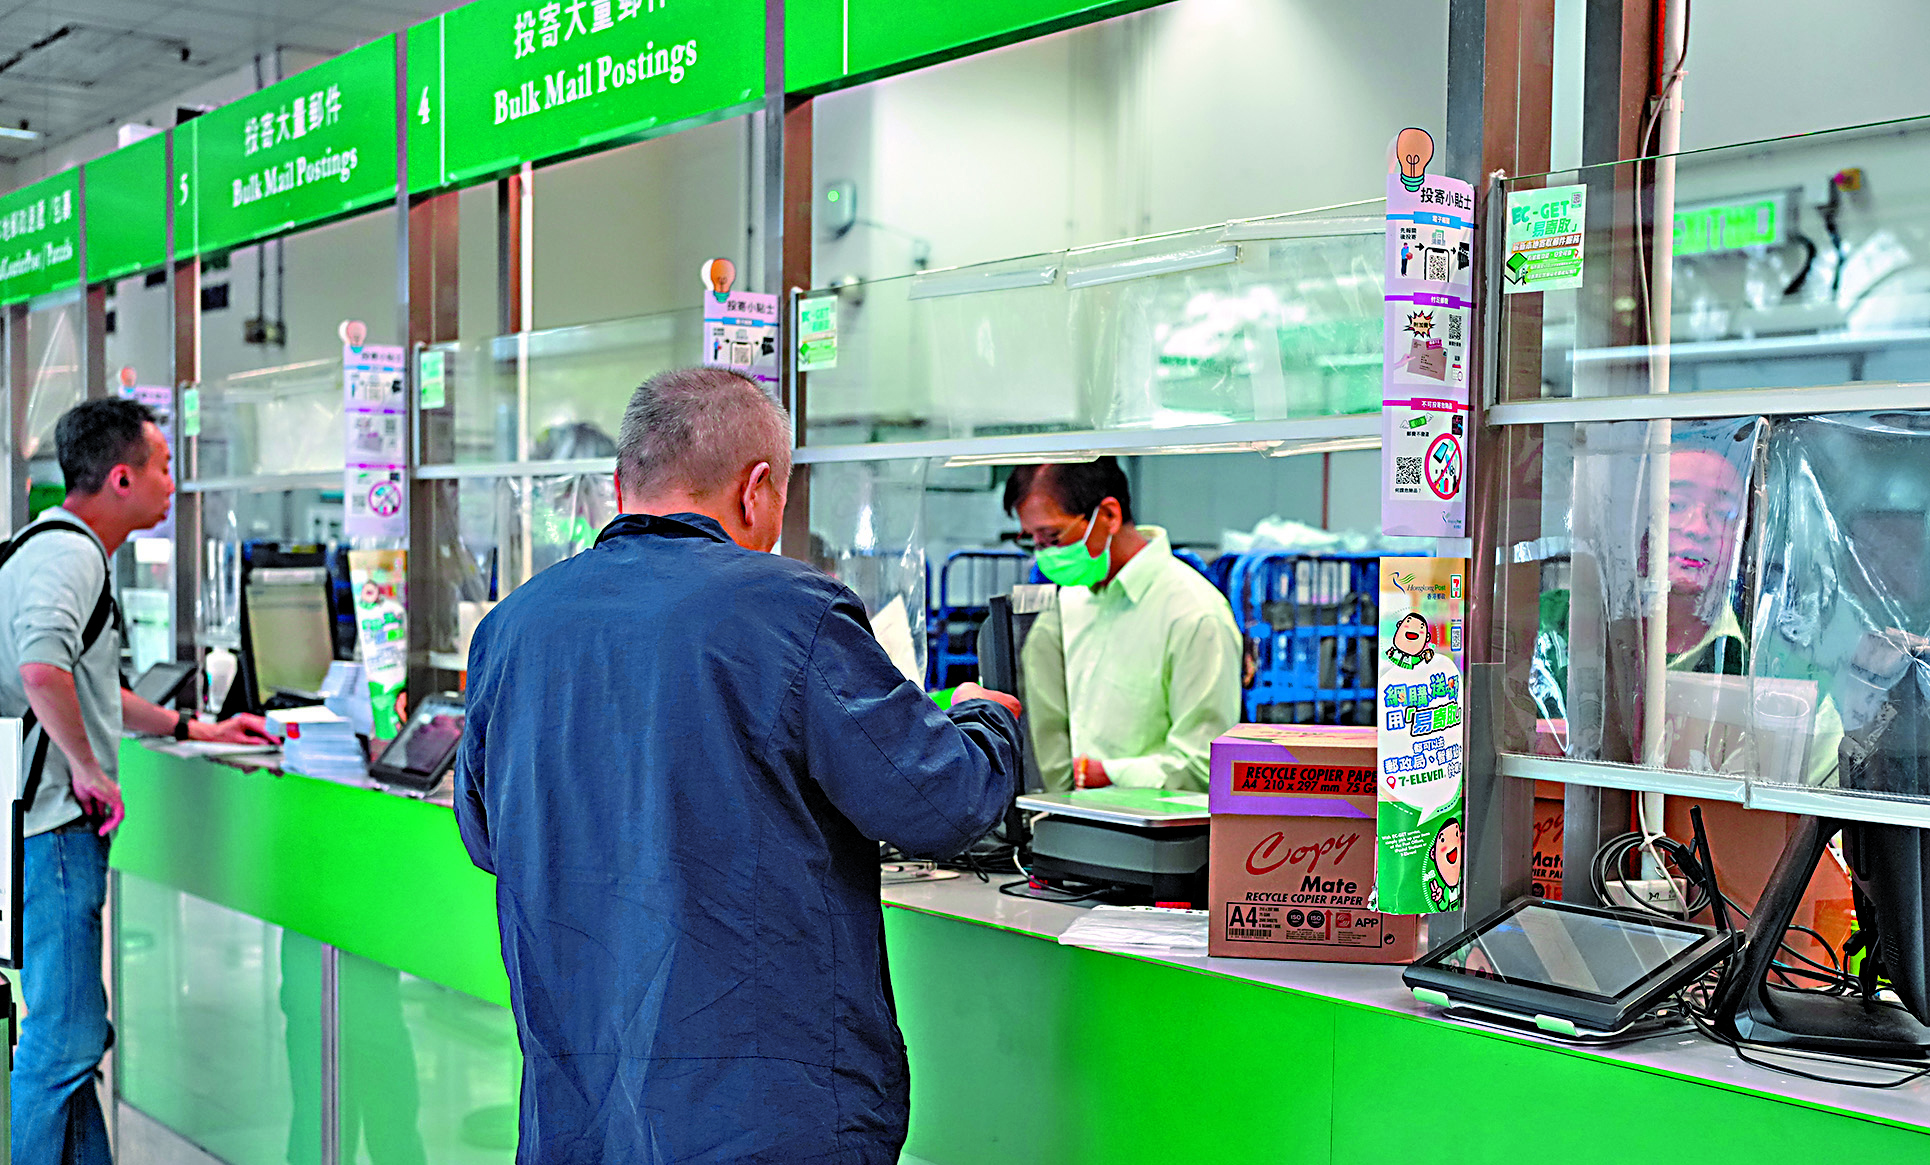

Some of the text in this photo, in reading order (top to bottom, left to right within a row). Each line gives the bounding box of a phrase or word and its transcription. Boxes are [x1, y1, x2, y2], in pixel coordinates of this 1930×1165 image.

[513, 0, 666, 59] 投寄大量
[494, 39, 698, 125] Bulk Mail Postings
[418, 86, 430, 124] 4
[243, 83, 342, 157] 投寄大量郵件
[180, 173, 188, 206] 5
[232, 147, 358, 208] Bulk Mail Postings
[1420, 186, 1472, 210] 投寄小貼士
[1242, 779, 1257, 790] A4
[1264, 780, 1284, 791] 210
[1286, 783, 1294, 791] x
[1297, 781, 1318, 792] 297
[1320, 784, 1340, 793] mm
[1346, 782, 1360, 793] 75
[1246, 766, 1296, 781] RECYCLE
[1300, 768, 1343, 782] COPIER
[1533, 814, 1564, 849] py
[1246, 831, 1360, 876] Copy
[1533, 851, 1563, 868] Mat
[1246, 892, 1363, 906] RECYCLE COPIER PAPER
[1300, 876, 1358, 894] Mate
[1229, 906, 1258, 928] A4
[1355, 917, 1379, 928] APP
